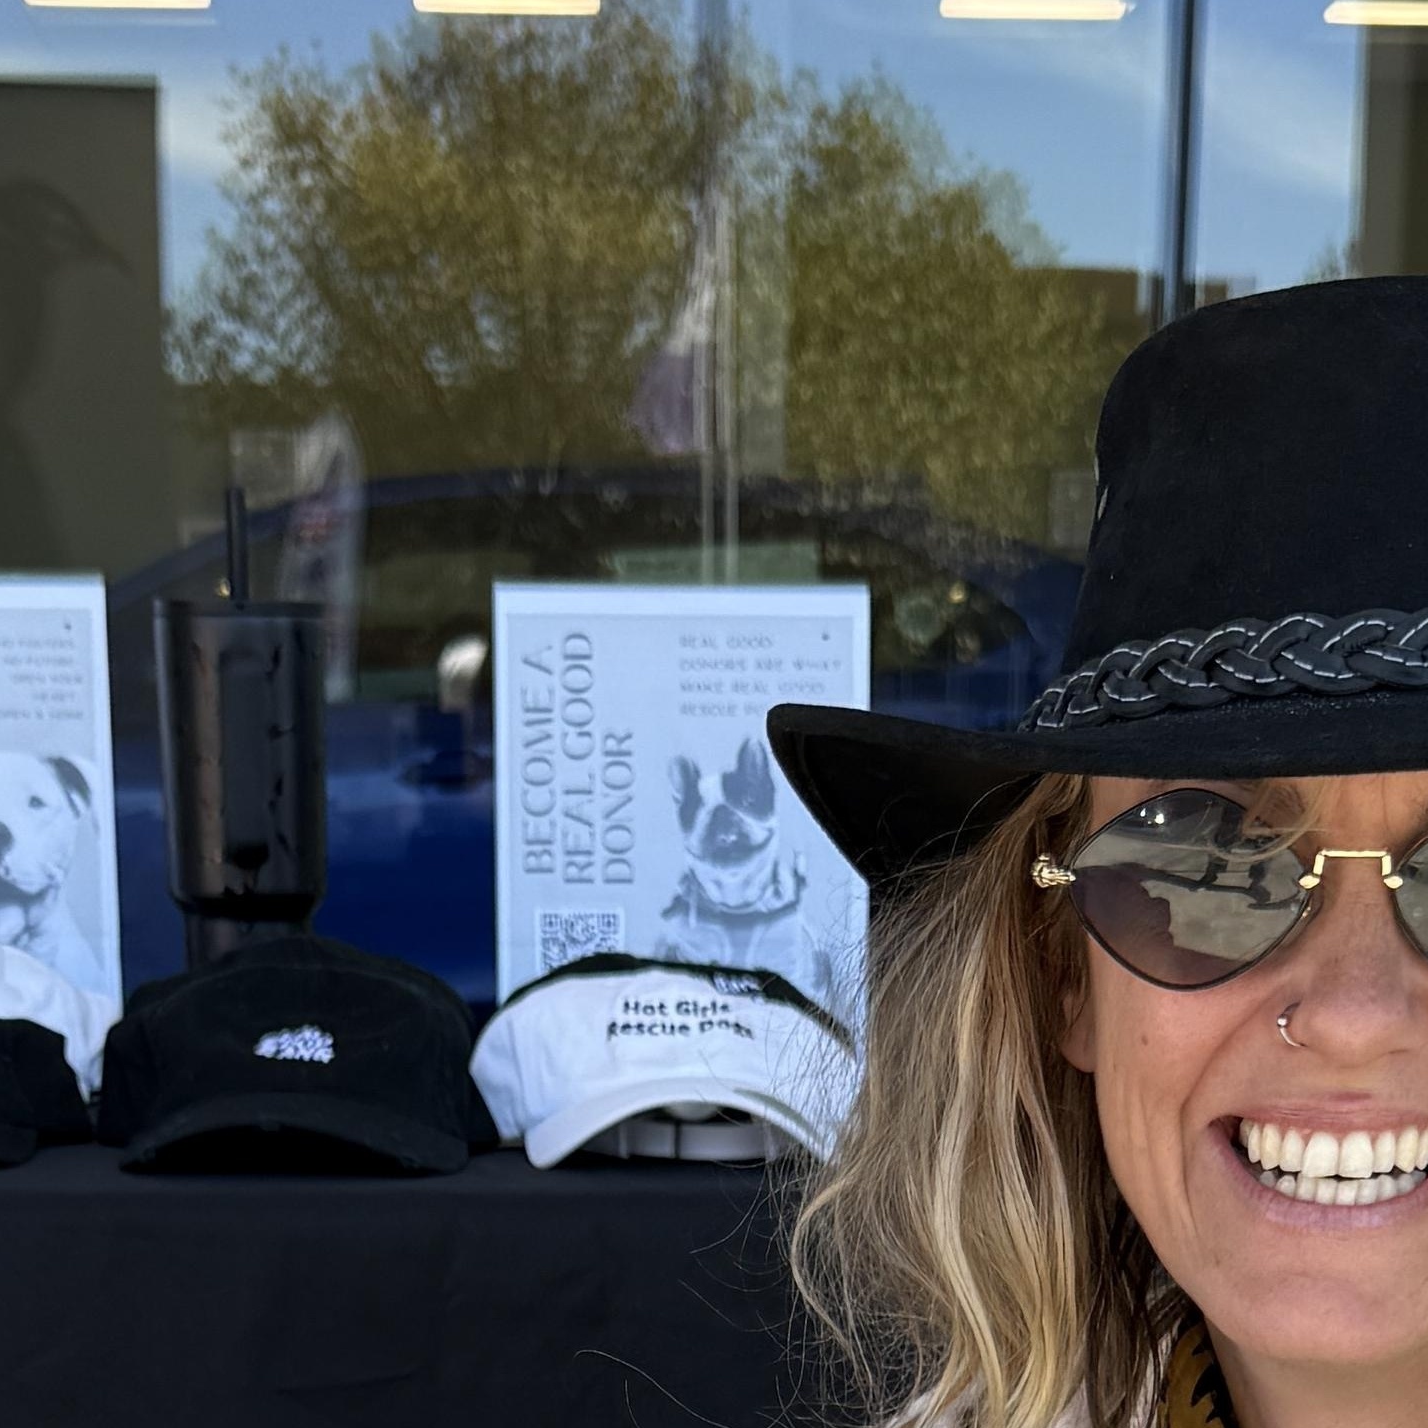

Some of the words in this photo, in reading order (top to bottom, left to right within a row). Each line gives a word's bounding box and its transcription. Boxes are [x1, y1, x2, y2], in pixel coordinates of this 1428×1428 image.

[561, 631, 595, 762] GOOD
[521, 688, 557, 875] BECOME
[562, 773, 596, 885] REAL
[601, 731, 635, 885] DONOR
[606, 1020, 691, 1042] Rescue
[623, 1000, 669, 1017] Hot
